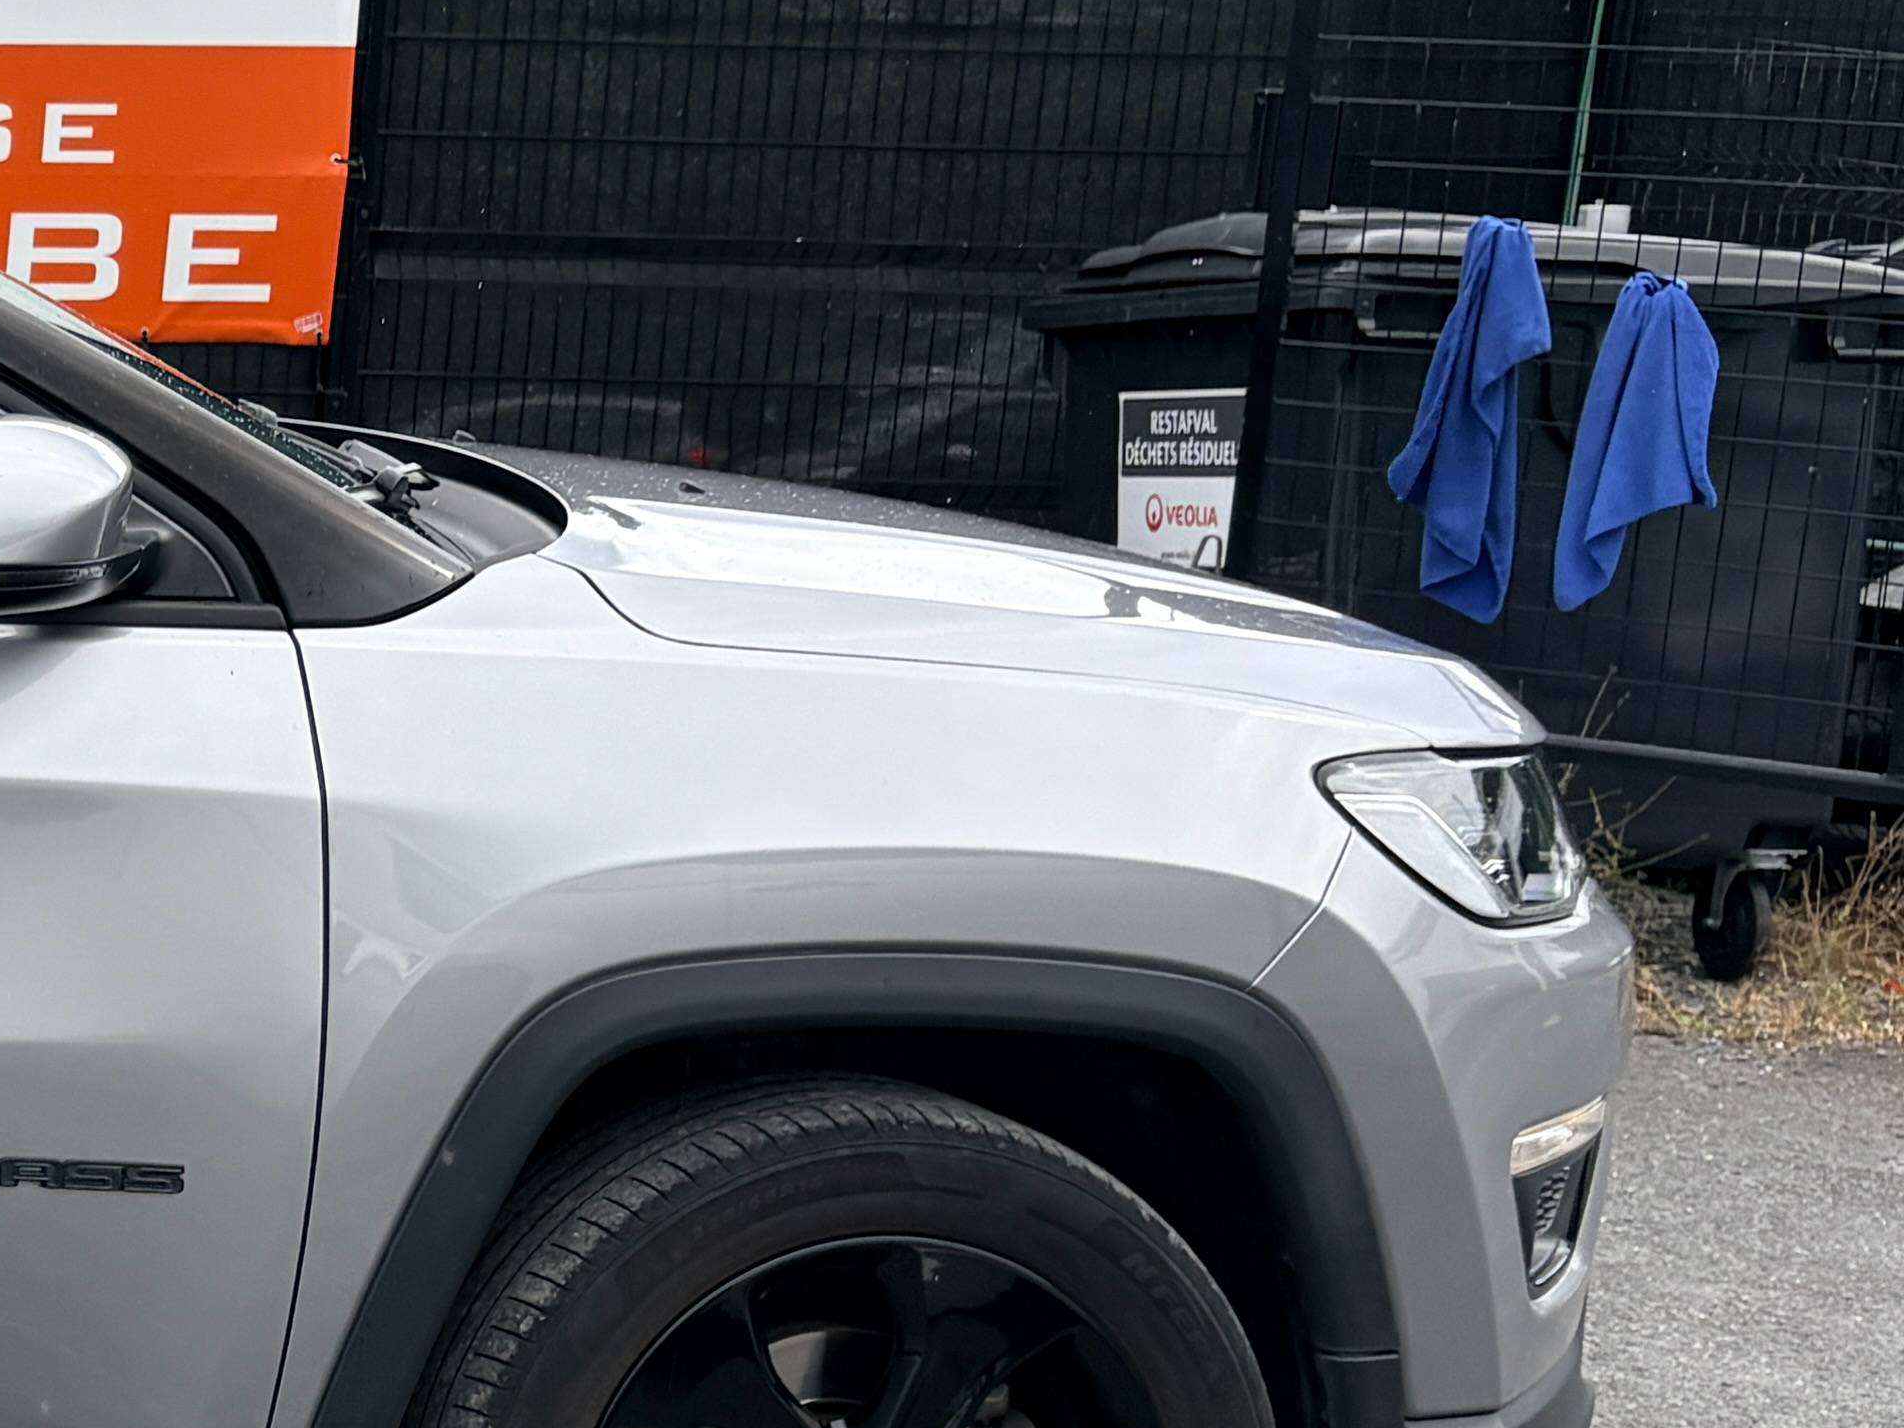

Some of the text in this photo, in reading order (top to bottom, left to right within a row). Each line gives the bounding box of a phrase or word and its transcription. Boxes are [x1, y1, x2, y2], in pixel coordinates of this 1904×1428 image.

[1150, 409, 1218, 435] RESTAFVAL
[1125, 436, 1239, 466] DÉCHETS RÉSIDUEL
[1166, 504, 1218, 527] VEOLIA
